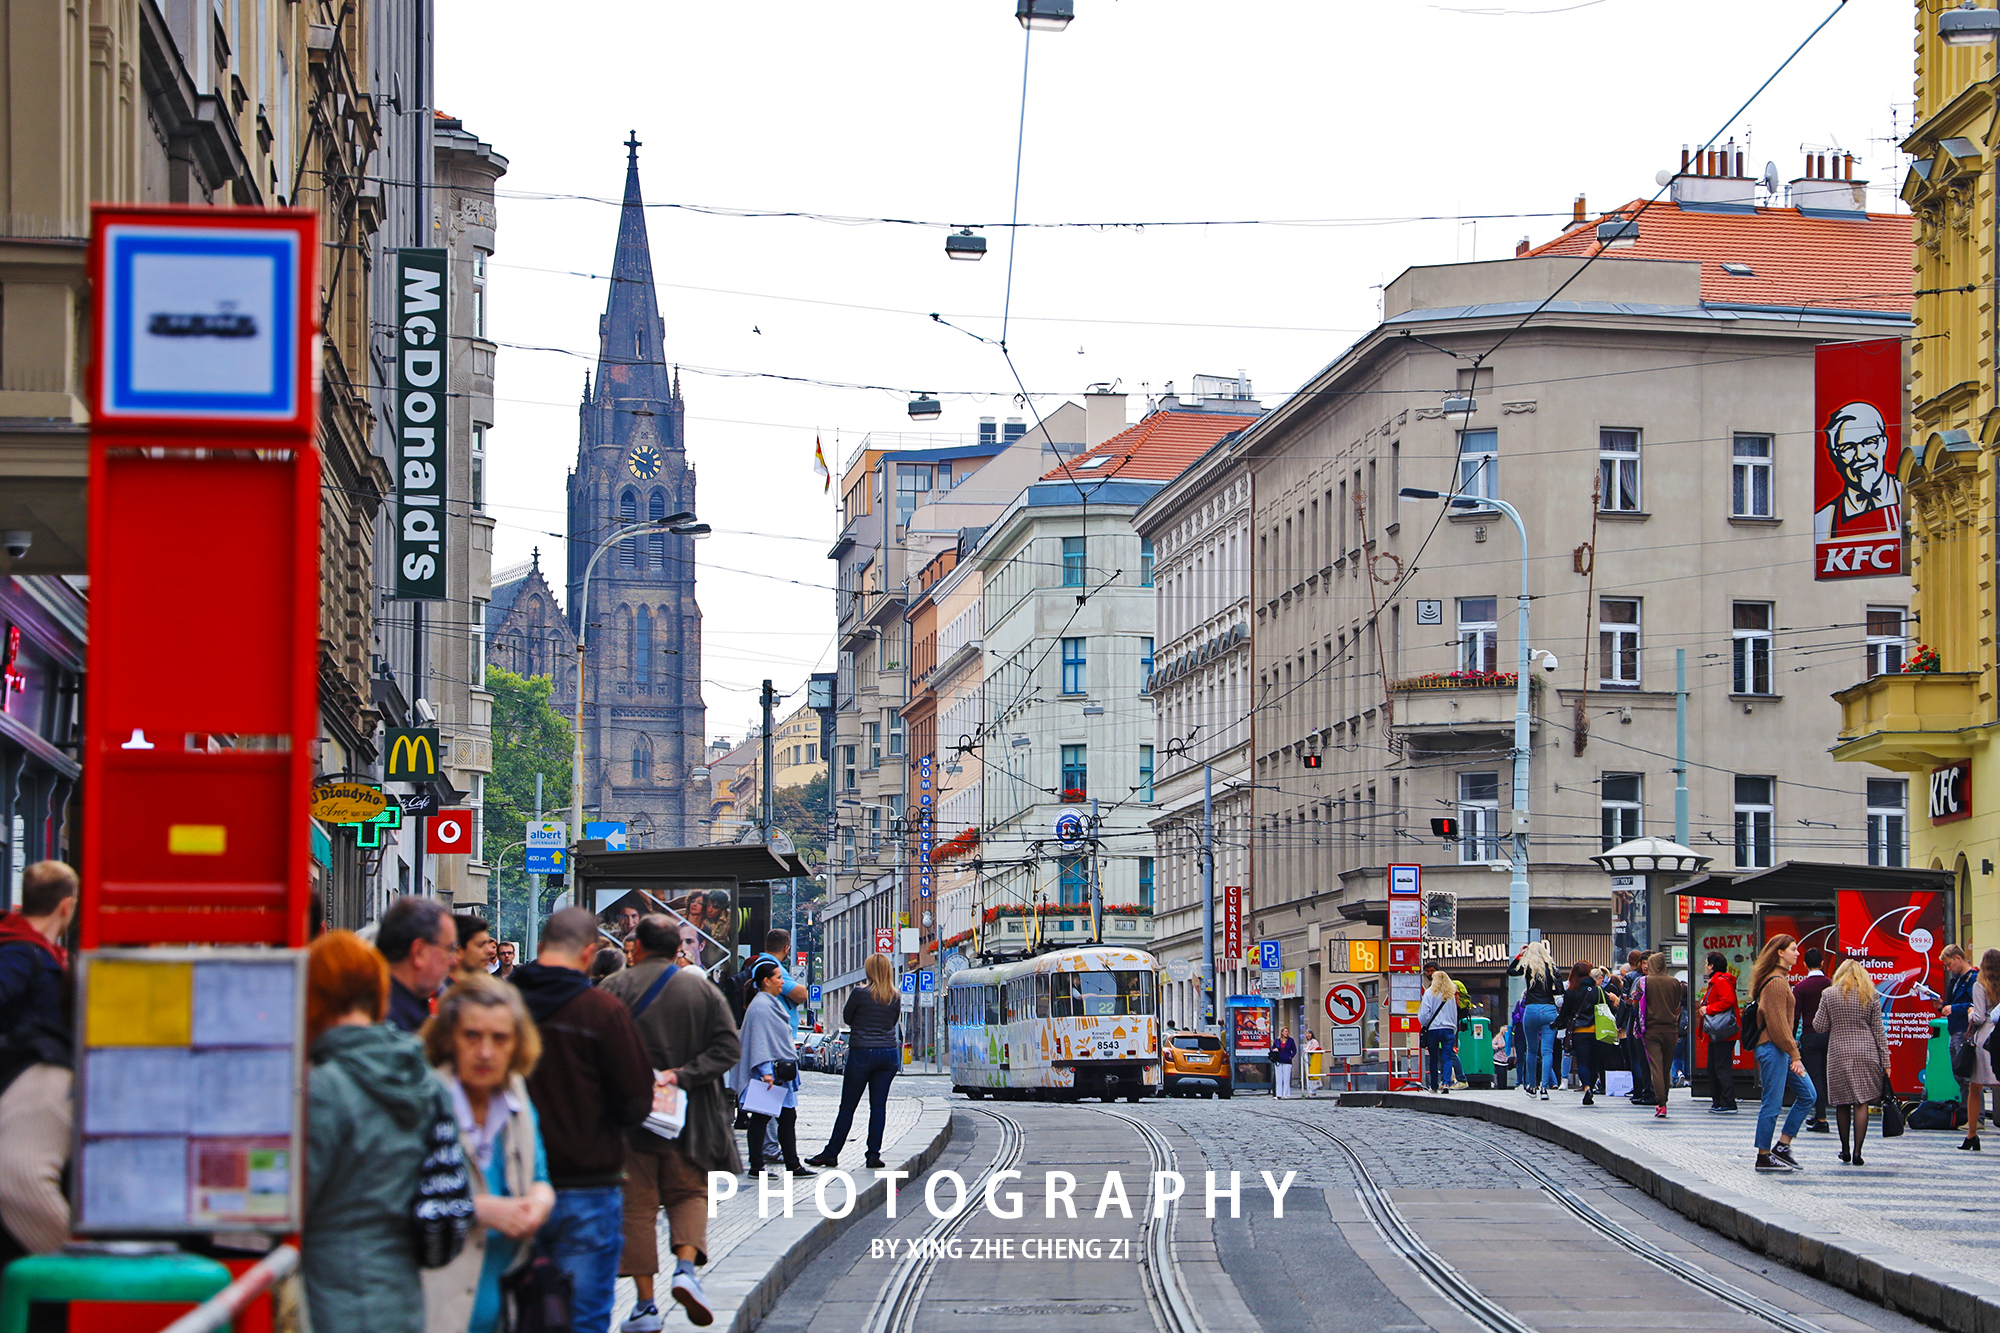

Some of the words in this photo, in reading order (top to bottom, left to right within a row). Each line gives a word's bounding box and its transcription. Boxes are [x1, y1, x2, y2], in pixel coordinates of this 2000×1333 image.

[403, 267, 440, 580] McDonald's
[1823, 545, 1894, 573] KFC
[921, 758, 931, 790] DŮM
[1928, 767, 1960, 818] KFC
[530, 831, 562, 839] albert
[1229, 887, 1237, 958] CUKRÁRNA
[1703, 935, 1742, 949] CRAZY
[1264, 944, 1276, 960] P
[1422, 940, 1473, 959] GETERIE
[1846, 946, 1868, 956] Tarif
[905, 976, 912, 986] P
[923, 974, 930, 985] P
[812, 987, 819, 996] P
[1098, 1002, 1114, 1014] 22
[1098, 1041, 1120, 1050] 8543
